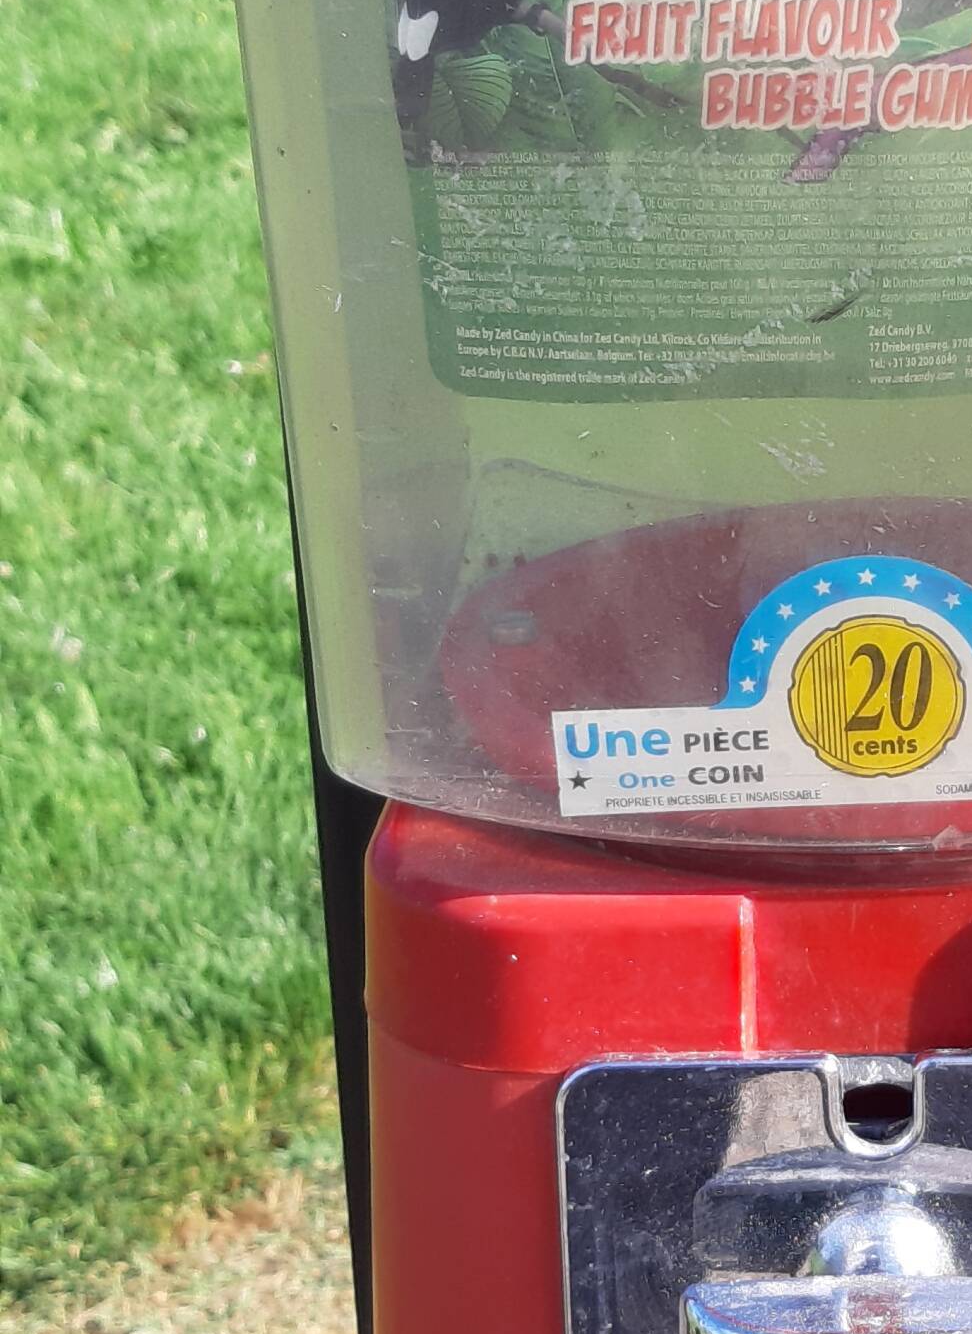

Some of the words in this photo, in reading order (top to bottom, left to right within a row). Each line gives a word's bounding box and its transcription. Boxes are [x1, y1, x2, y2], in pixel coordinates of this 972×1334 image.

[701, 64, 875, 130] BUBBLE
[482, 326, 494, 341] by
[494, 328, 512, 340] Zed
[513, 329, 541, 344] Candy
[868, 325, 886, 338] Zed
[888, 324, 915, 339] Candy
[457, 343, 489, 357] Europe
[490, 344, 502, 359] by
[869, 342, 880, 353] 17
[844, 641, 932, 732] 20
[564, 722, 672, 760] Une
[684, 727, 770, 754] PIÈCE
[853, 735, 918, 757] cents
[618, 772, 676, 789] One
[687, 764, 764, 785] COIN
[730, 791, 743, 803] ET
